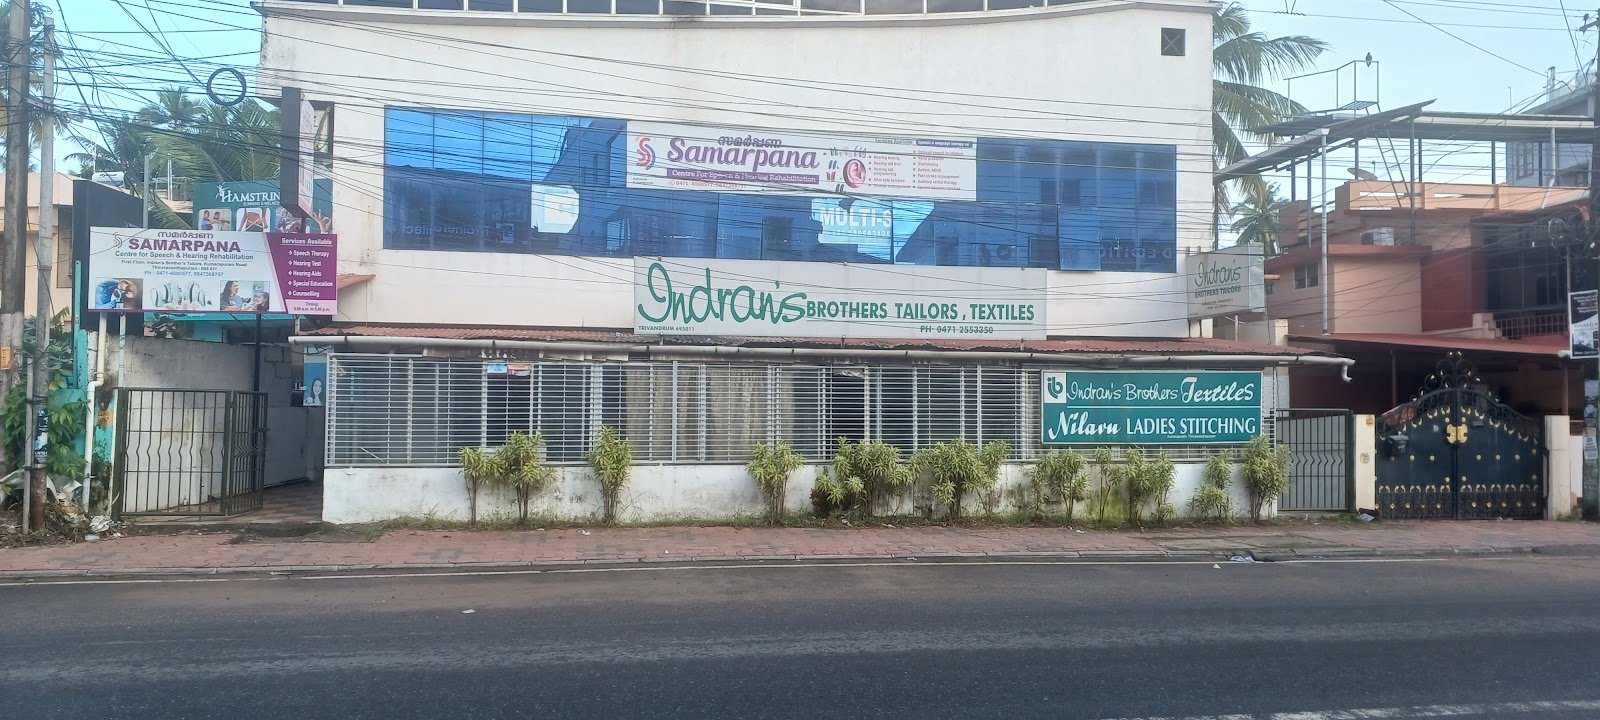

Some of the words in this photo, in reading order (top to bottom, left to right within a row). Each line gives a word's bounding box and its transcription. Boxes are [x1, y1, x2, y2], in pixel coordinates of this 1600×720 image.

[667, 137, 820, 173] Samarpana
[672, 169, 696, 177] Centre
[769, 174, 816, 183] Rehabilitation
[129, 238, 241, 253] SAMARPANA
[149, 251, 175, 259] Speech
[182, 252, 208, 260] Hearing
[311, 250, 330, 258] Therapy
[1195, 259, 1242, 287] Indran's
[293, 290, 320, 298] Counselling
[638, 263, 808, 325] Indran's
[1194, 289, 1219, 299] BROTHERS
[1219, 285, 1242, 295] TAILORS
[806, 300, 888, 320] BROTHERS
[894, 302, 959, 320] TAILORS
[969, 303, 1035, 321] TEXTILES
[937, 326, 959, 334] 0471
[959, 326, 994, 334] 2553350
[1067, 382, 1121, 401] Indran's
[1123, 383, 1178, 401] Brothers
[1180, 376, 1254, 403] Textiles
[1126, 417, 1175, 435] LADIES
[1180, 417, 1256, 435] STITCHING
